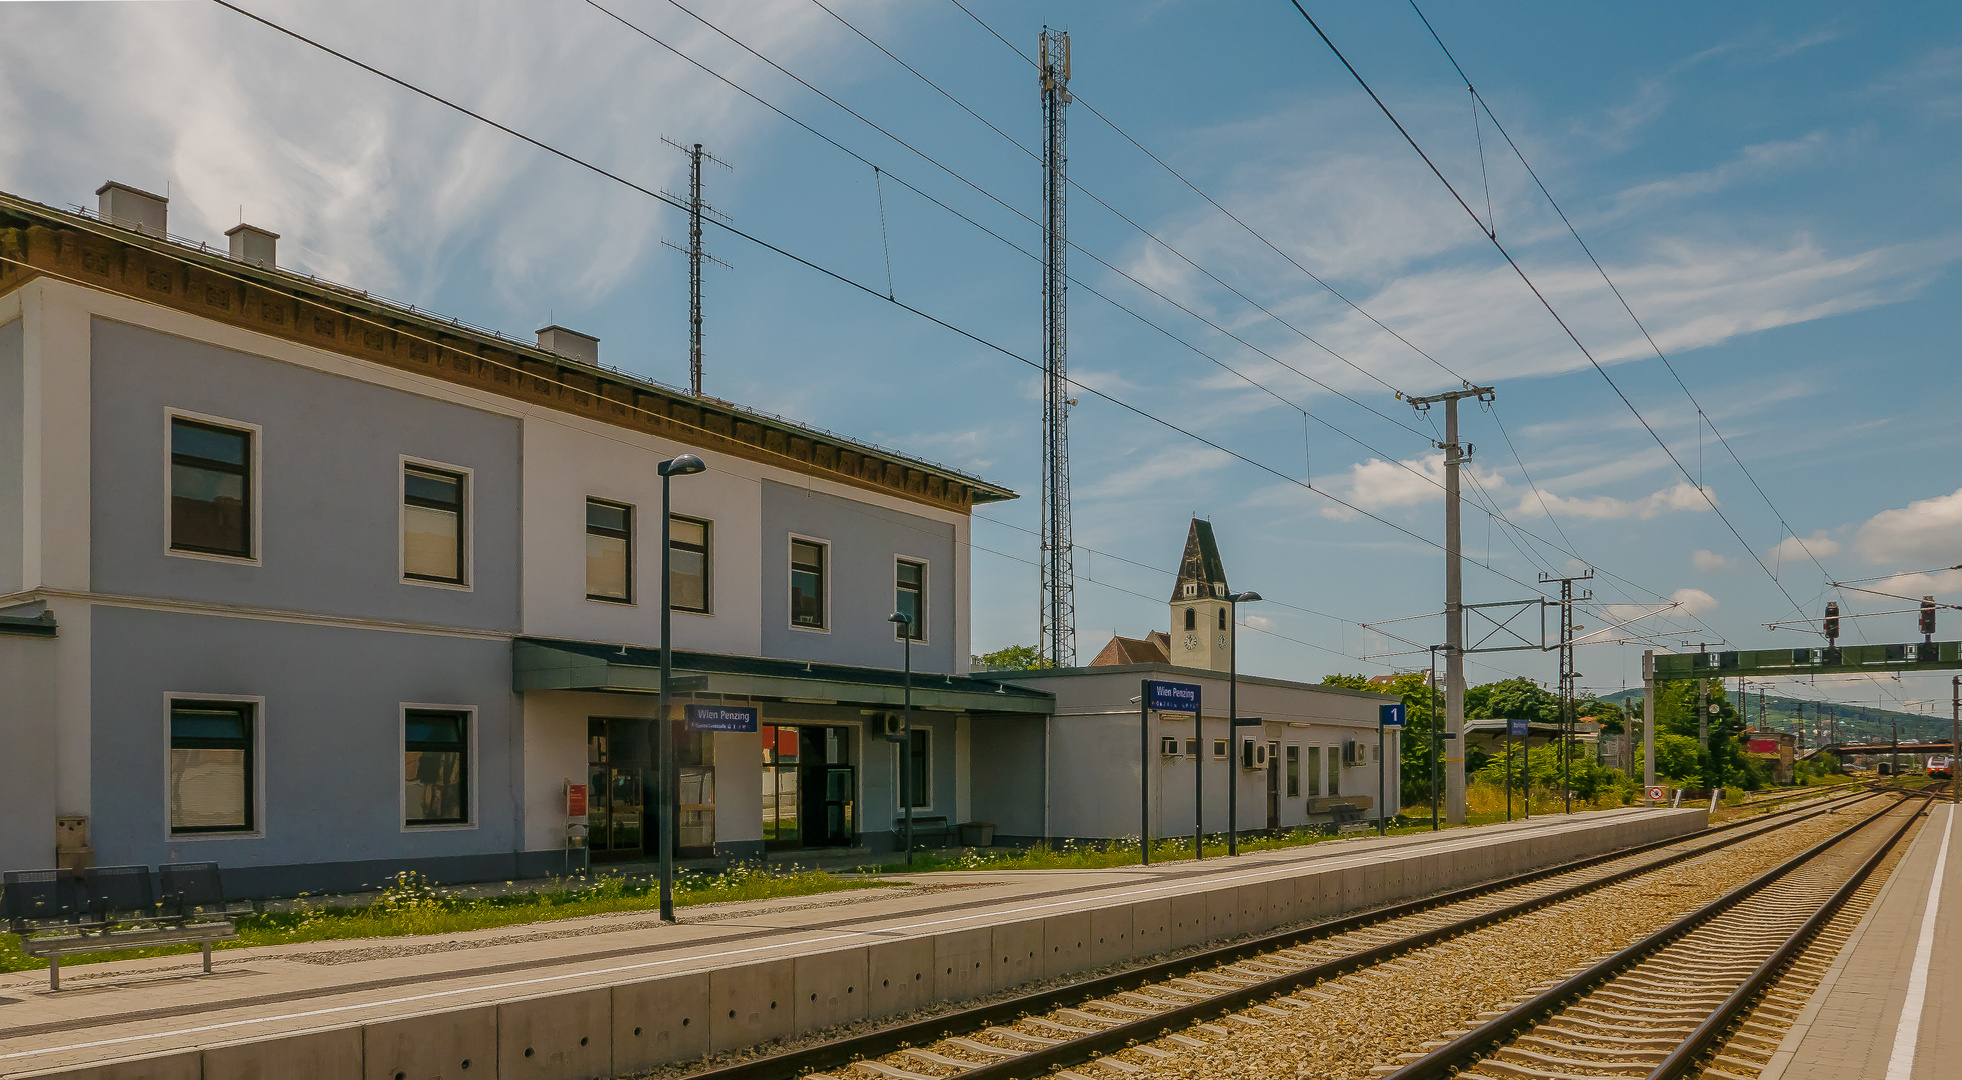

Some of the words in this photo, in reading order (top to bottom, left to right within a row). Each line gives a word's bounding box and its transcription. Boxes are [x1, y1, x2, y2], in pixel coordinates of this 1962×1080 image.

[1156, 686, 1172, 696] Wien
[1173, 687, 1194, 701] Penzing
[698, 709, 718, 720] Wien
[720, 710, 750, 722] Penzing
[1391, 708, 1397, 721] 1
